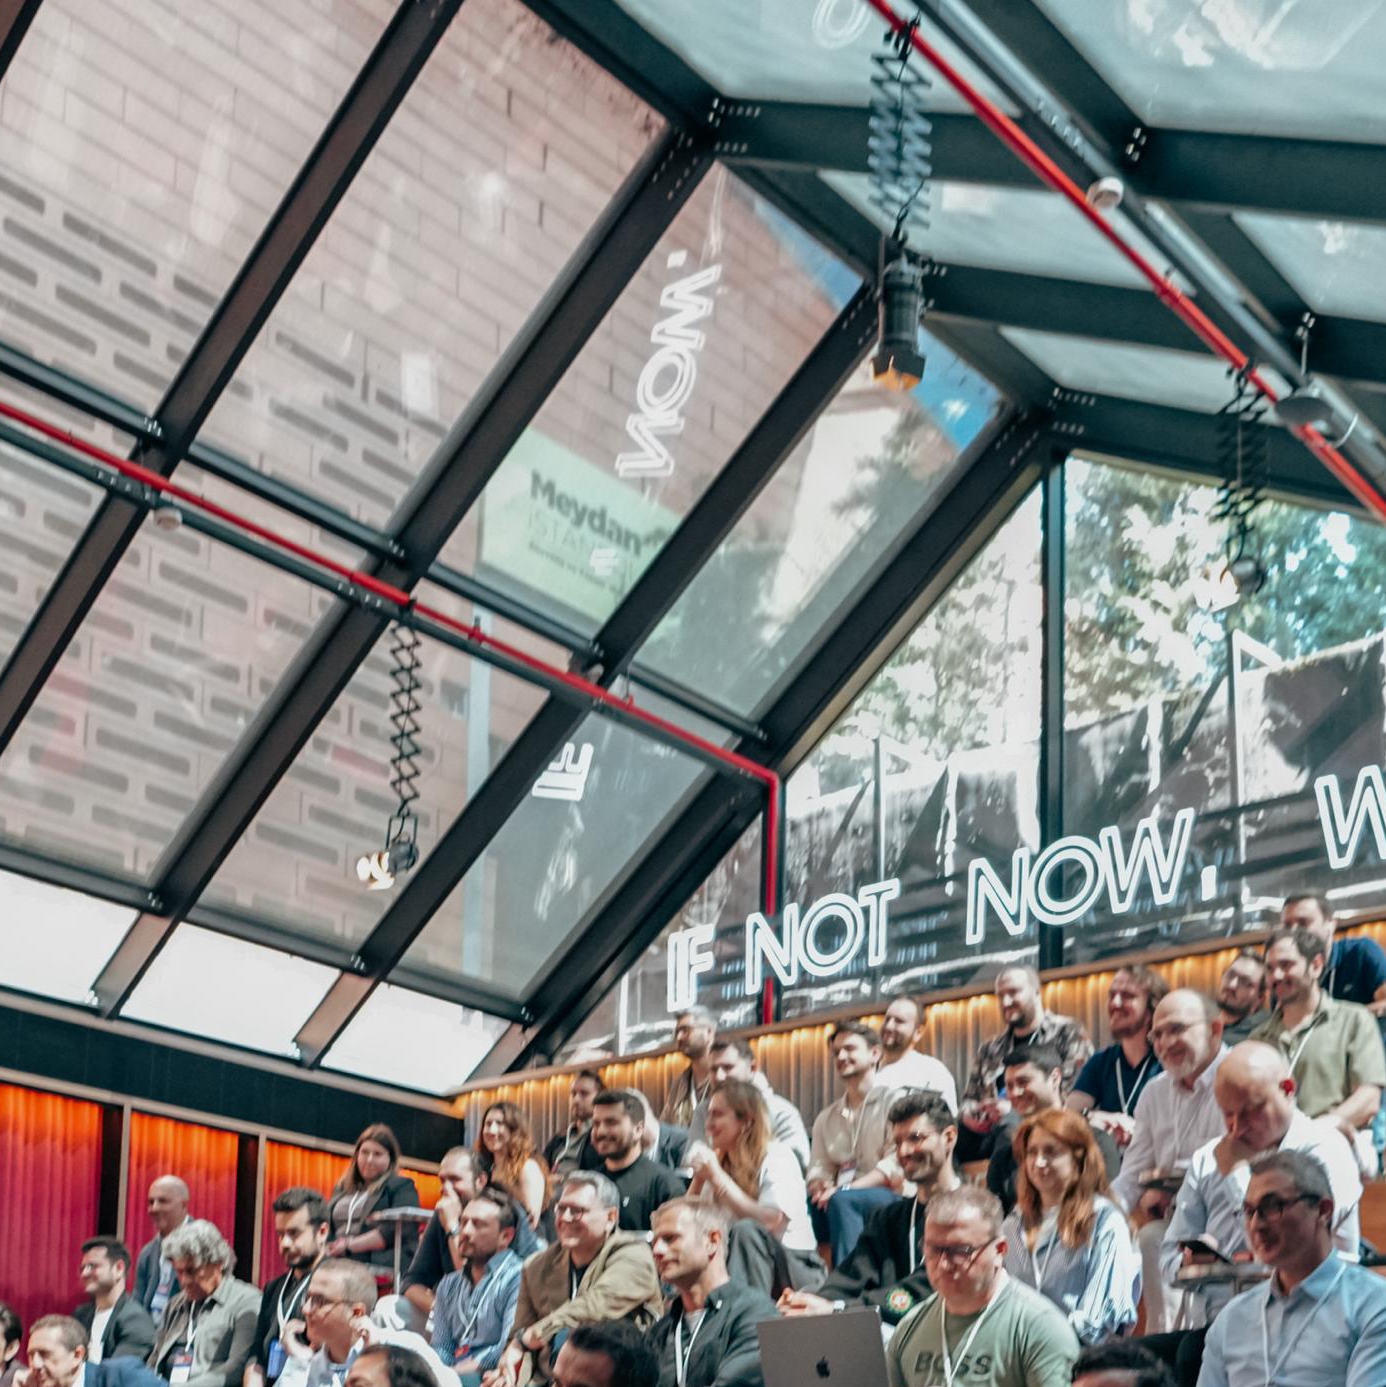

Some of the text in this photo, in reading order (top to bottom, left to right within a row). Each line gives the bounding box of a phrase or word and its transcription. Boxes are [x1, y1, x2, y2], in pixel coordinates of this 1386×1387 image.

[531, 469, 642, 558] Meydan
[667, 924, 714, 1012] IF
[746, 878, 901, 995] NOT
